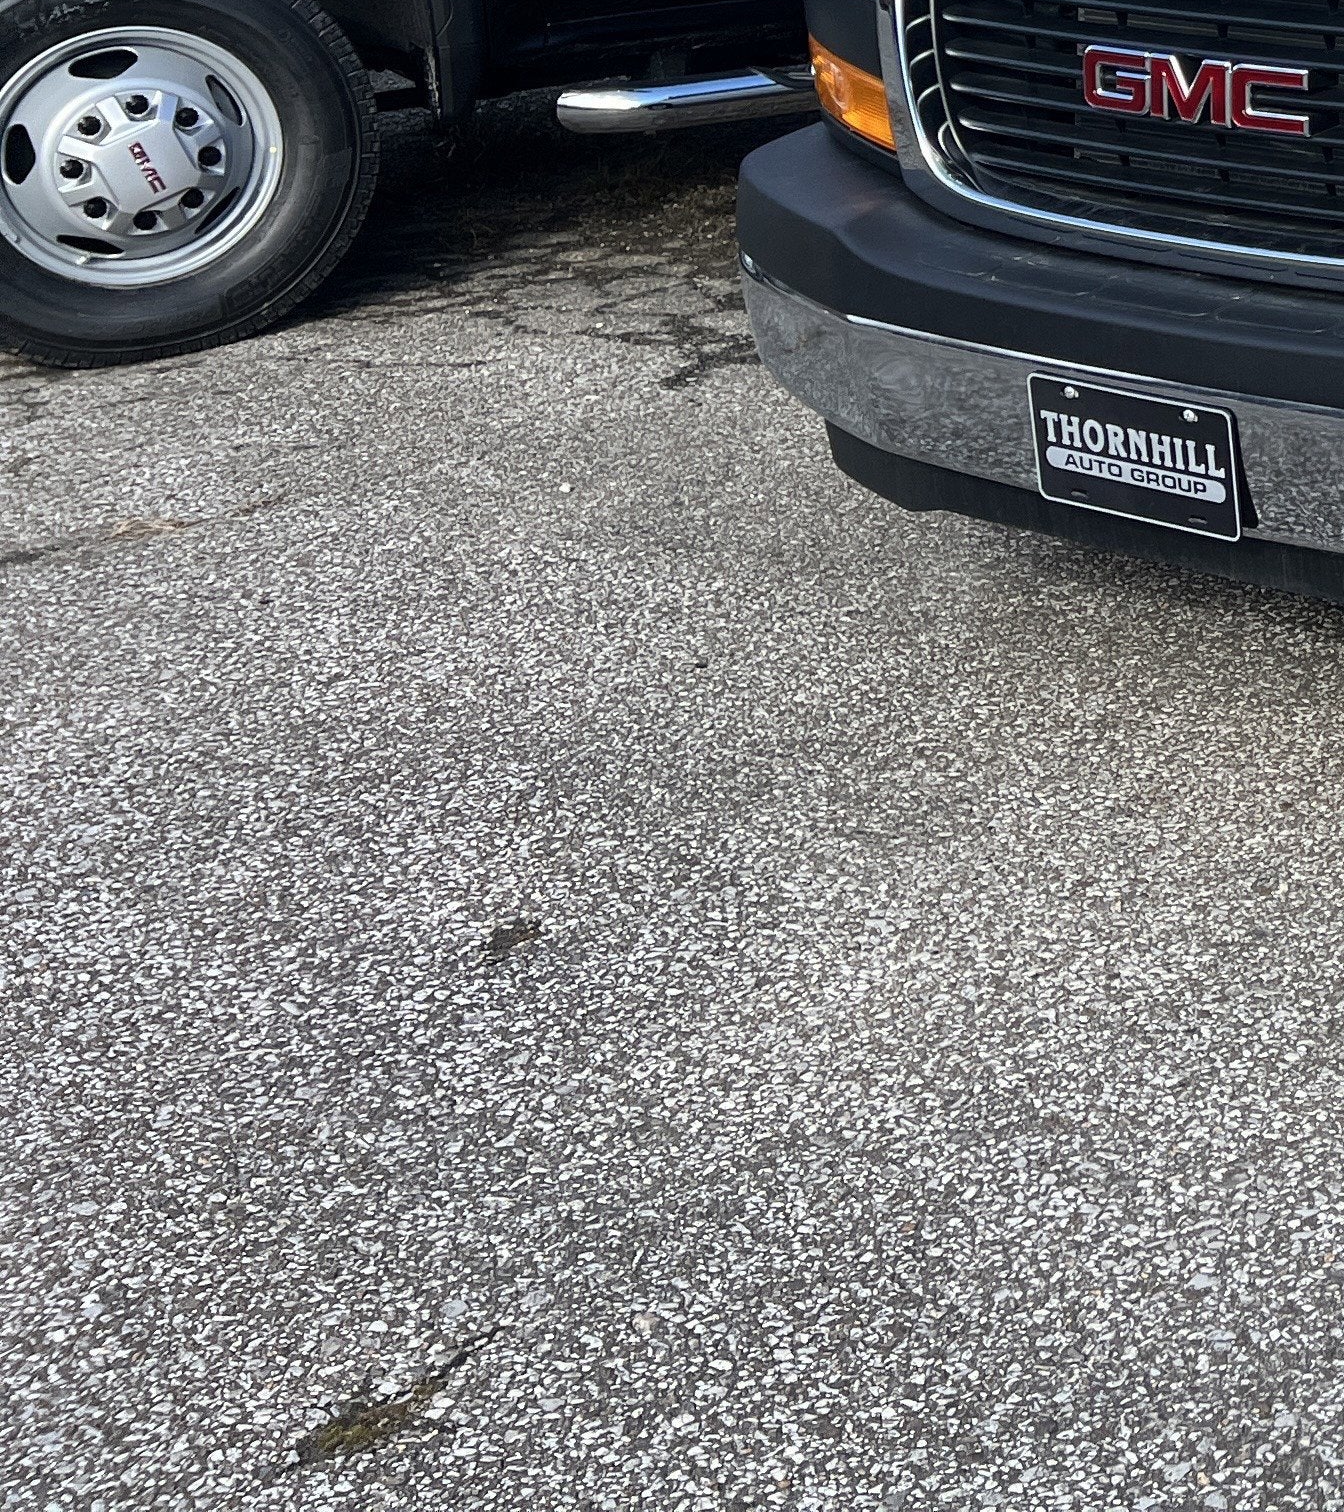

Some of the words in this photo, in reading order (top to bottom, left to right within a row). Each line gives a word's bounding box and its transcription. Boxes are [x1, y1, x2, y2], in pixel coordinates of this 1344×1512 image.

[1083, 44, 1310, 138] GMC
[128, 141, 167, 194] GMC
[1039, 409, 1226, 479] THORNHILL
[1064, 453, 1123, 478] AUTO
[1130, 467, 1207, 495] GROUP
